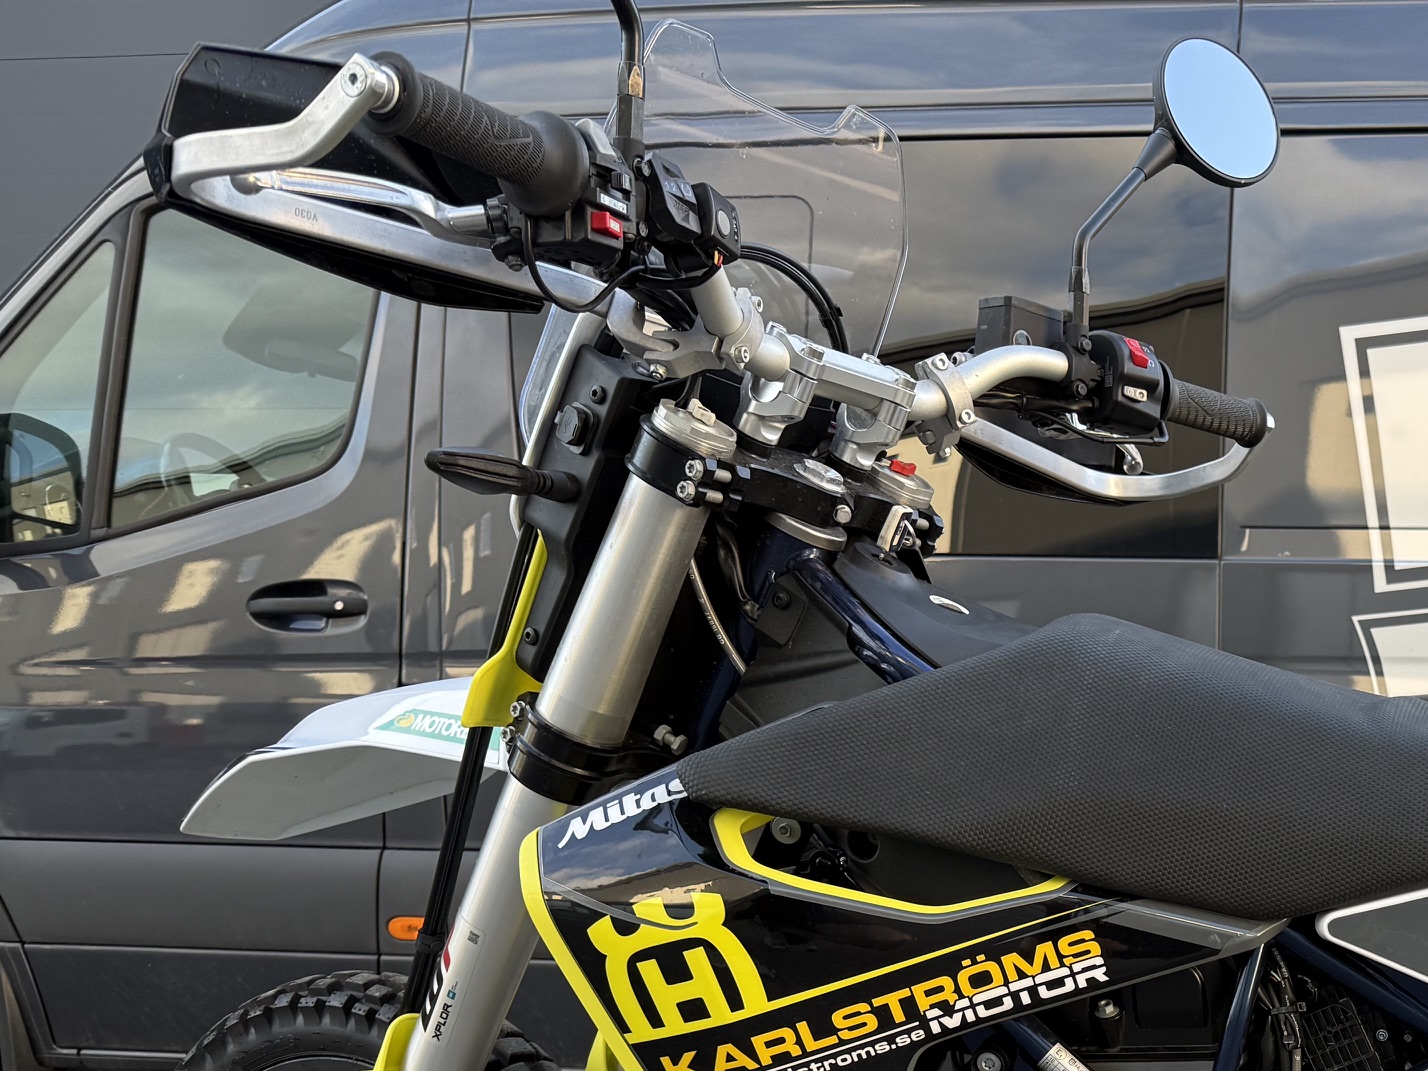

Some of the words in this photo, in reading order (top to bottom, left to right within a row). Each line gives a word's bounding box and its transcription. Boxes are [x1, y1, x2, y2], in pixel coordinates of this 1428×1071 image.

[557, 778, 689, 849] Mitas
[432, 1002, 453, 1042] XPLOR
[925, 956, 1111, 1036] MOTOR
